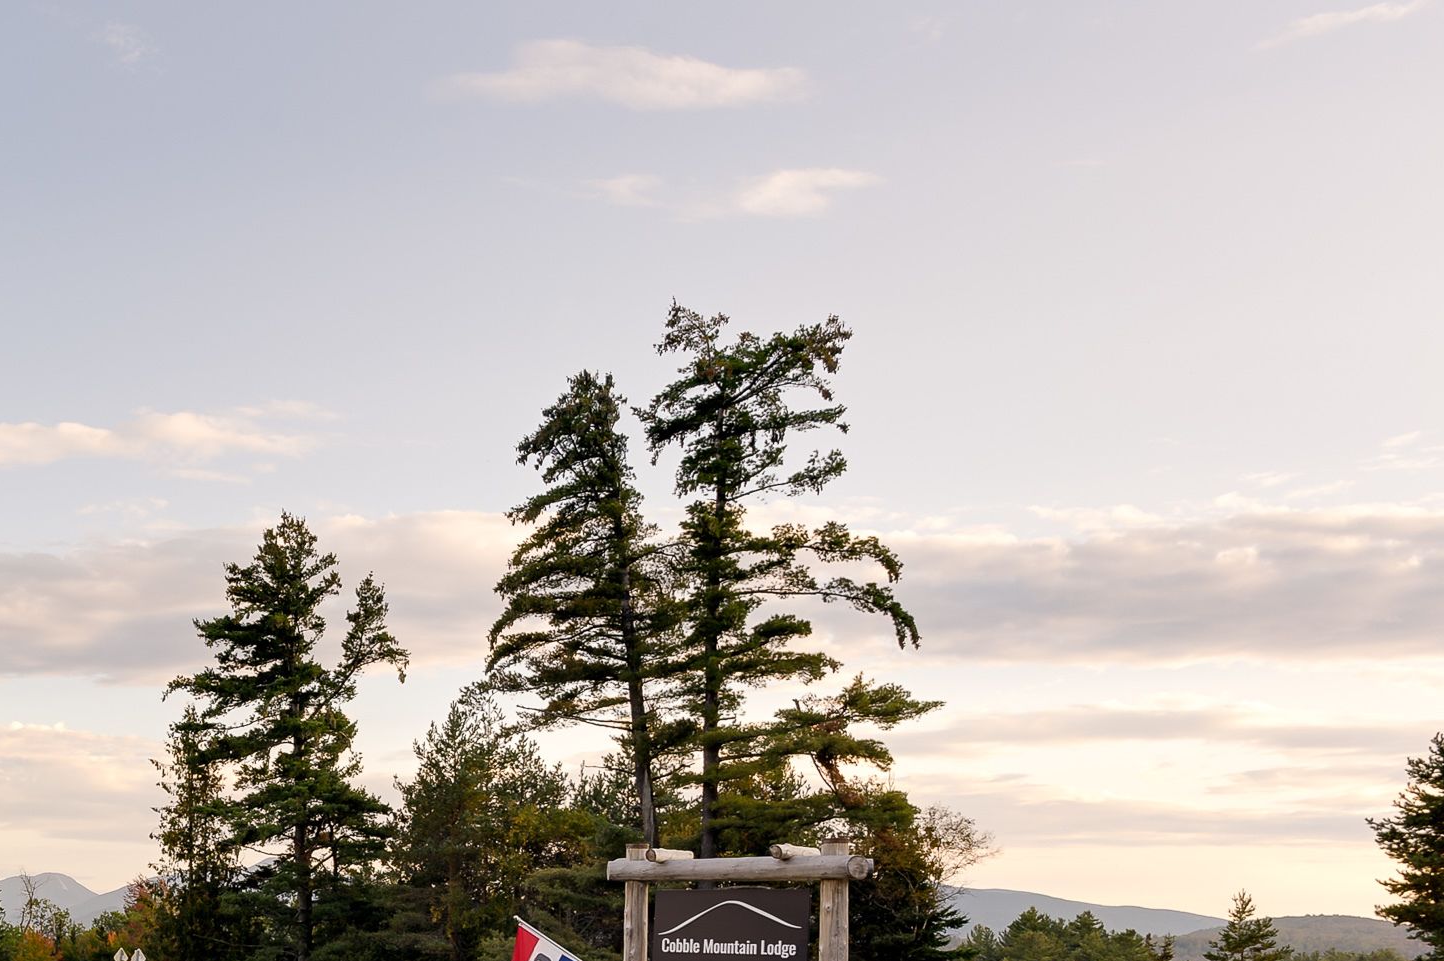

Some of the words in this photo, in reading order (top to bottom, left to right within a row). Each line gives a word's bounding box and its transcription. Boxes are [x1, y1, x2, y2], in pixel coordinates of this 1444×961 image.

[661, 937, 700, 954] Cobble
[703, 938, 757, 955] Mountain
[760, 939, 797, 959] Lodge
